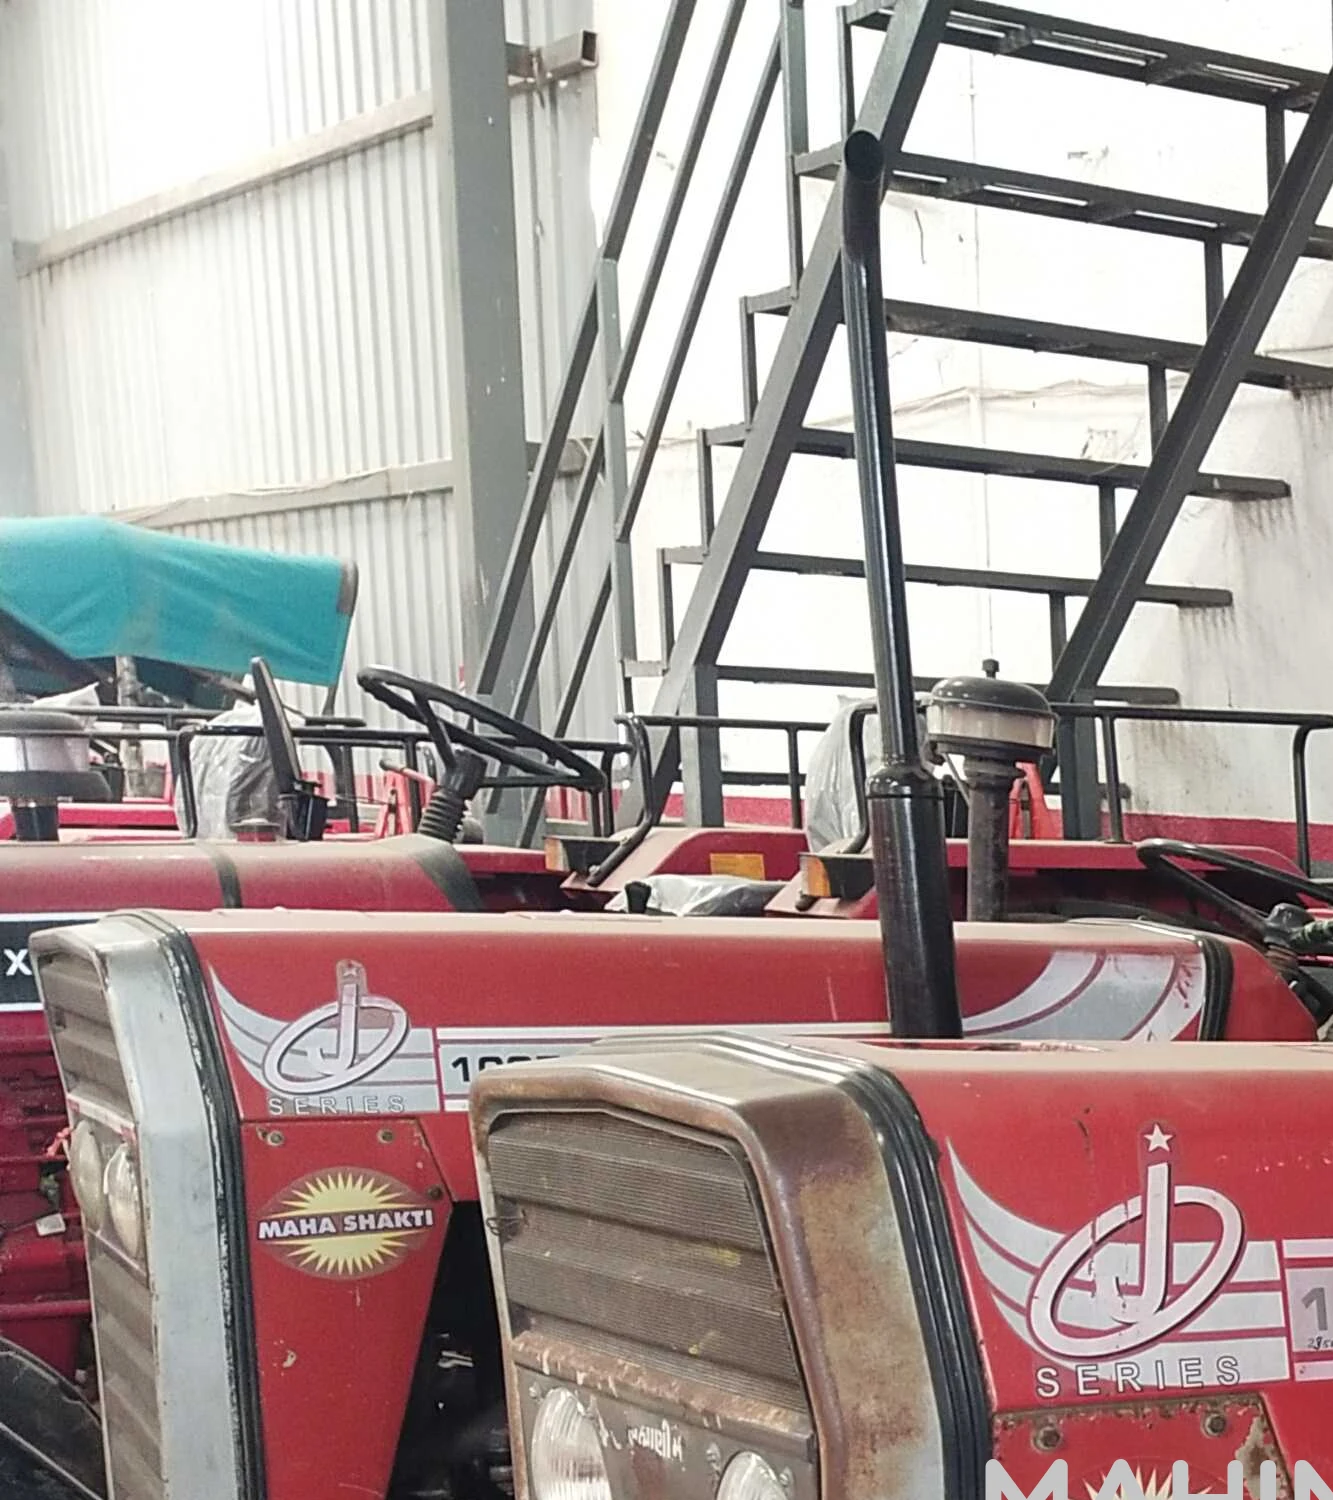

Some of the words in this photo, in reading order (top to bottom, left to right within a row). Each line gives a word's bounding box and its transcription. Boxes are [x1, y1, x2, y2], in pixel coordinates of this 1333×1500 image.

[267, 1096, 405, 1116] SERIES
[258, 1216, 337, 1240] MAHA
[343, 1208, 434, 1233] SHAKTI
[1035, 1355, 1241, 1398] SERIES
